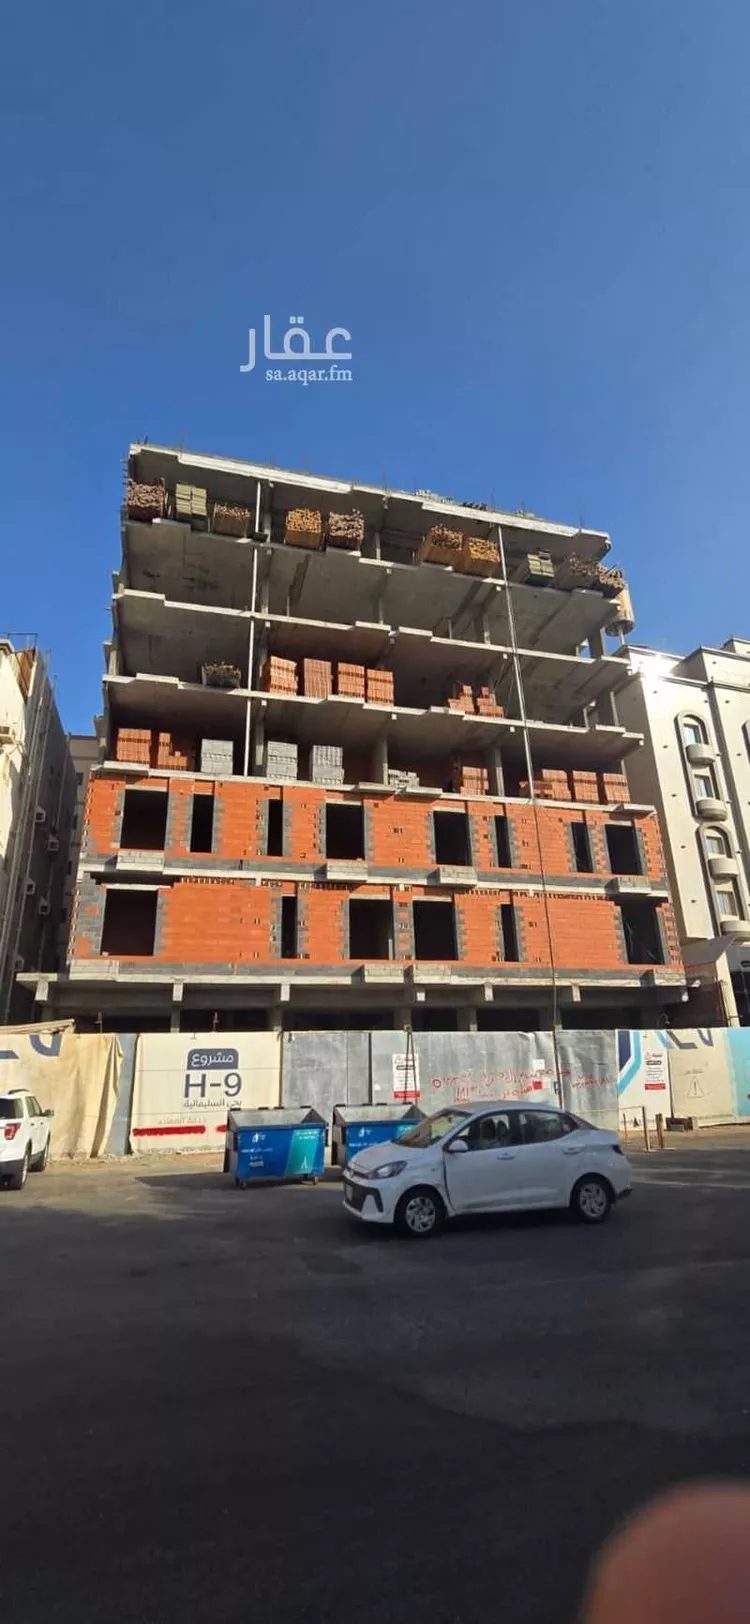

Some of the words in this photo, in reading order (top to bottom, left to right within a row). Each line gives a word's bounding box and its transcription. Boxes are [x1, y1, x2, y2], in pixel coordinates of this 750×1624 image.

[191, 1051, 234, 1068] مشروع
[184, 1072, 242, 1099] H-9
[183, 1098, 226, 1110] السليمانية
